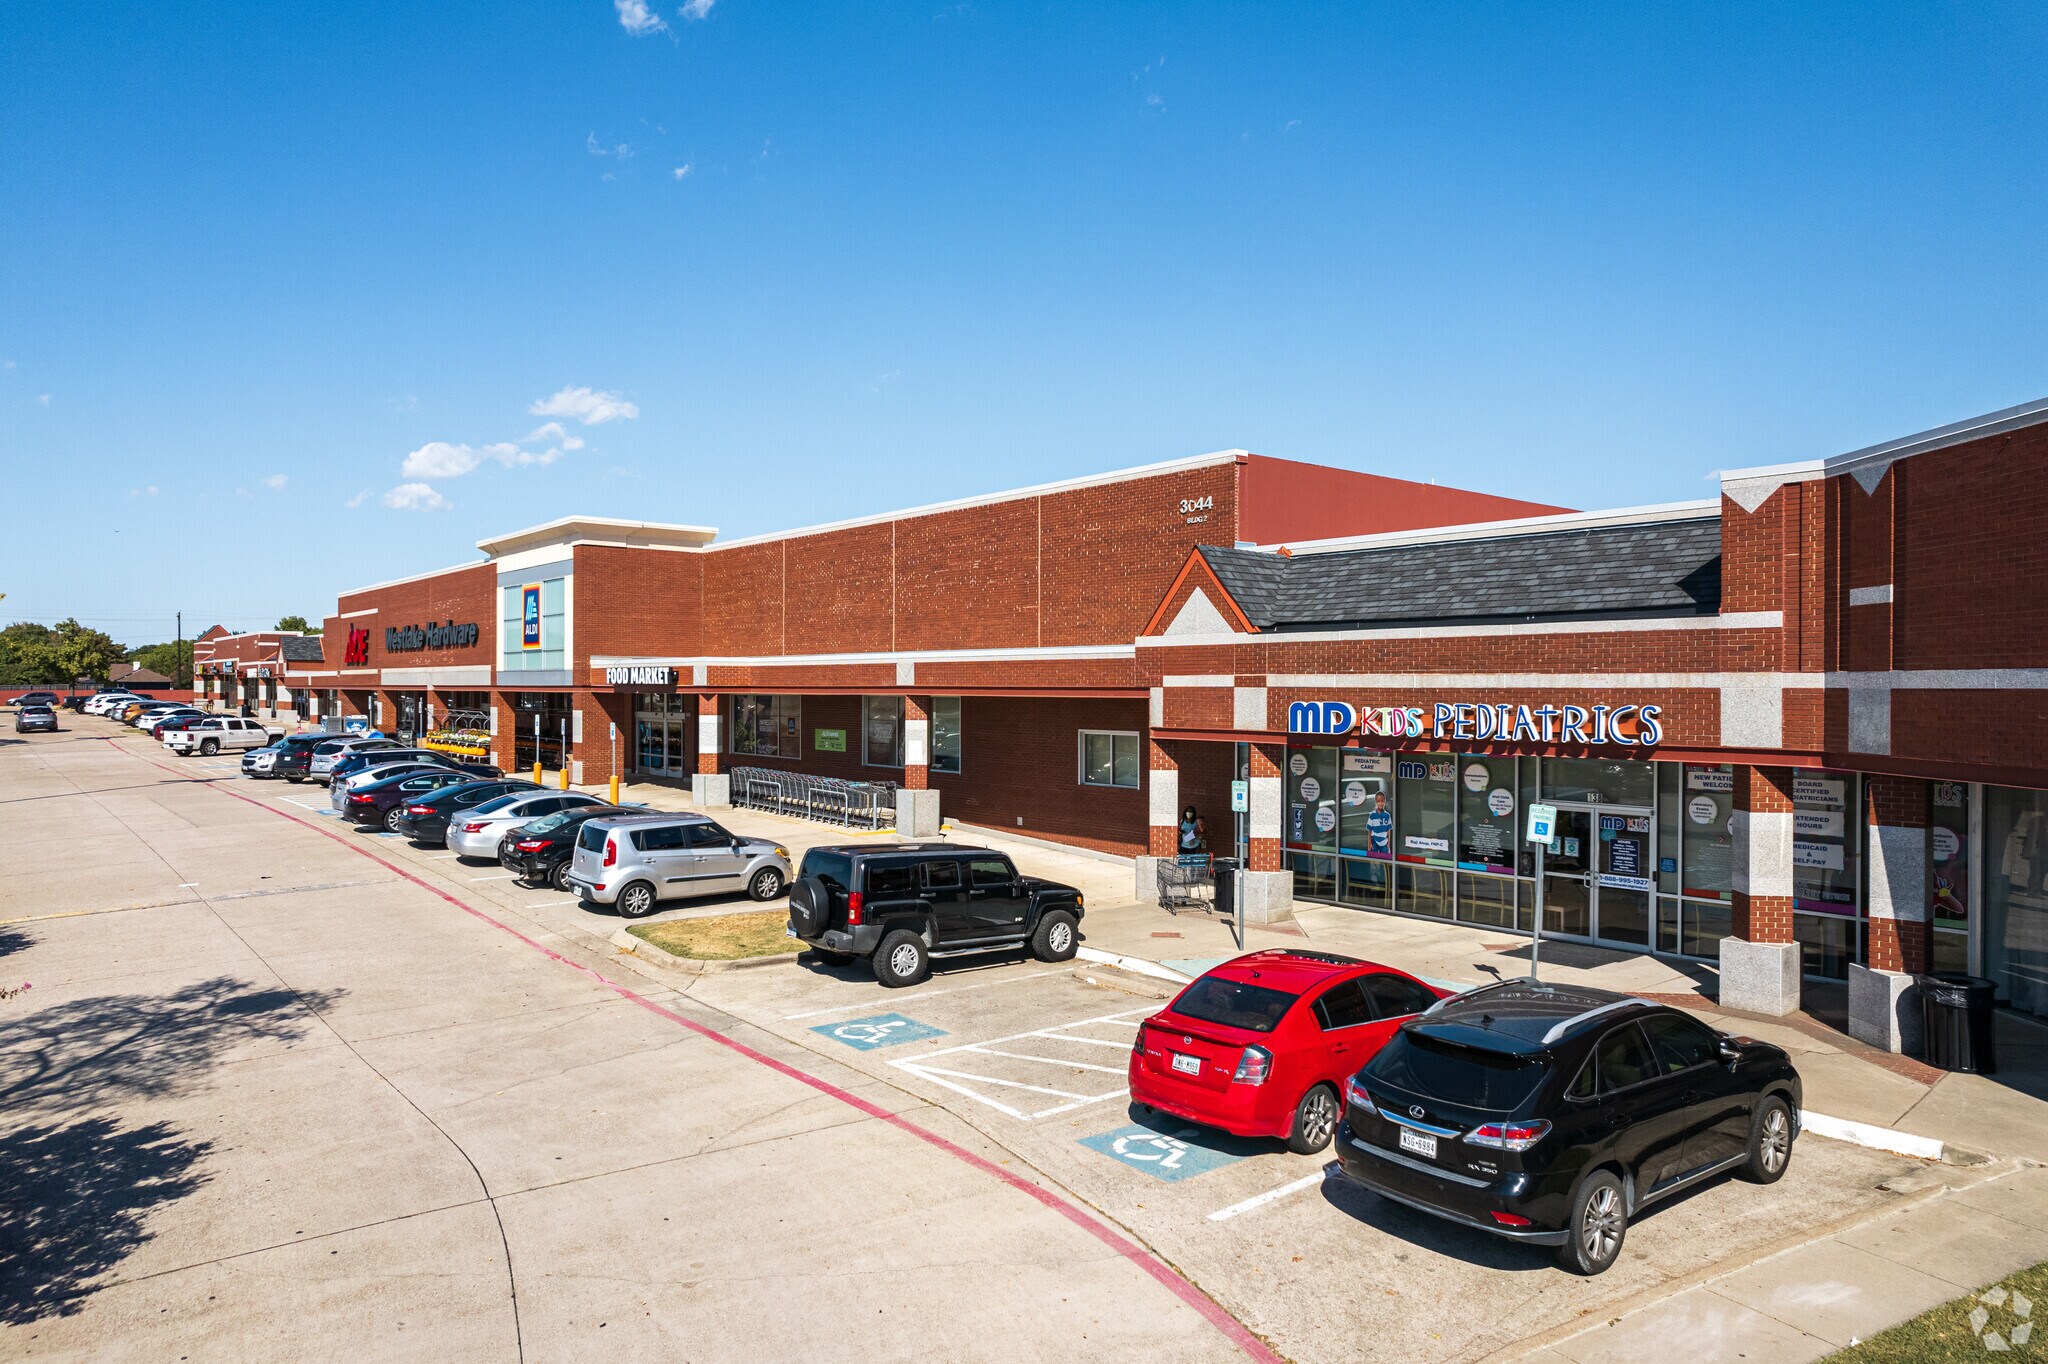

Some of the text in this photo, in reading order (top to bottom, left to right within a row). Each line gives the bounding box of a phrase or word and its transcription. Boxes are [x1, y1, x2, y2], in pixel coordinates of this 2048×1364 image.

[1180, 495, 1213, 514] 3044
[1187, 516, 1203, 524] BLDG
[385, 619, 478, 651] Westlake Hardware
[525, 623, 538, 636] ALDI
[606, 667, 670, 685] FOOD MARKET
[1289, 701, 1357, 735] MD
[1434, 703, 1663, 746] PEDIATRICS
[1398, 761, 1427, 780] MD
[1702, 781, 1733, 789] WELCOM
[1793, 794, 1839, 803] DIATRICIANS
[1933, 784, 1962, 801] IDS
[1600, 815, 1625, 831] MD
[1795, 815, 1830, 823] XTENDED
[1793, 844, 1828, 852] MEDICAID
[1793, 857, 1827, 866] SELF-PAY
[1467, 1163, 1480, 1171] RX
